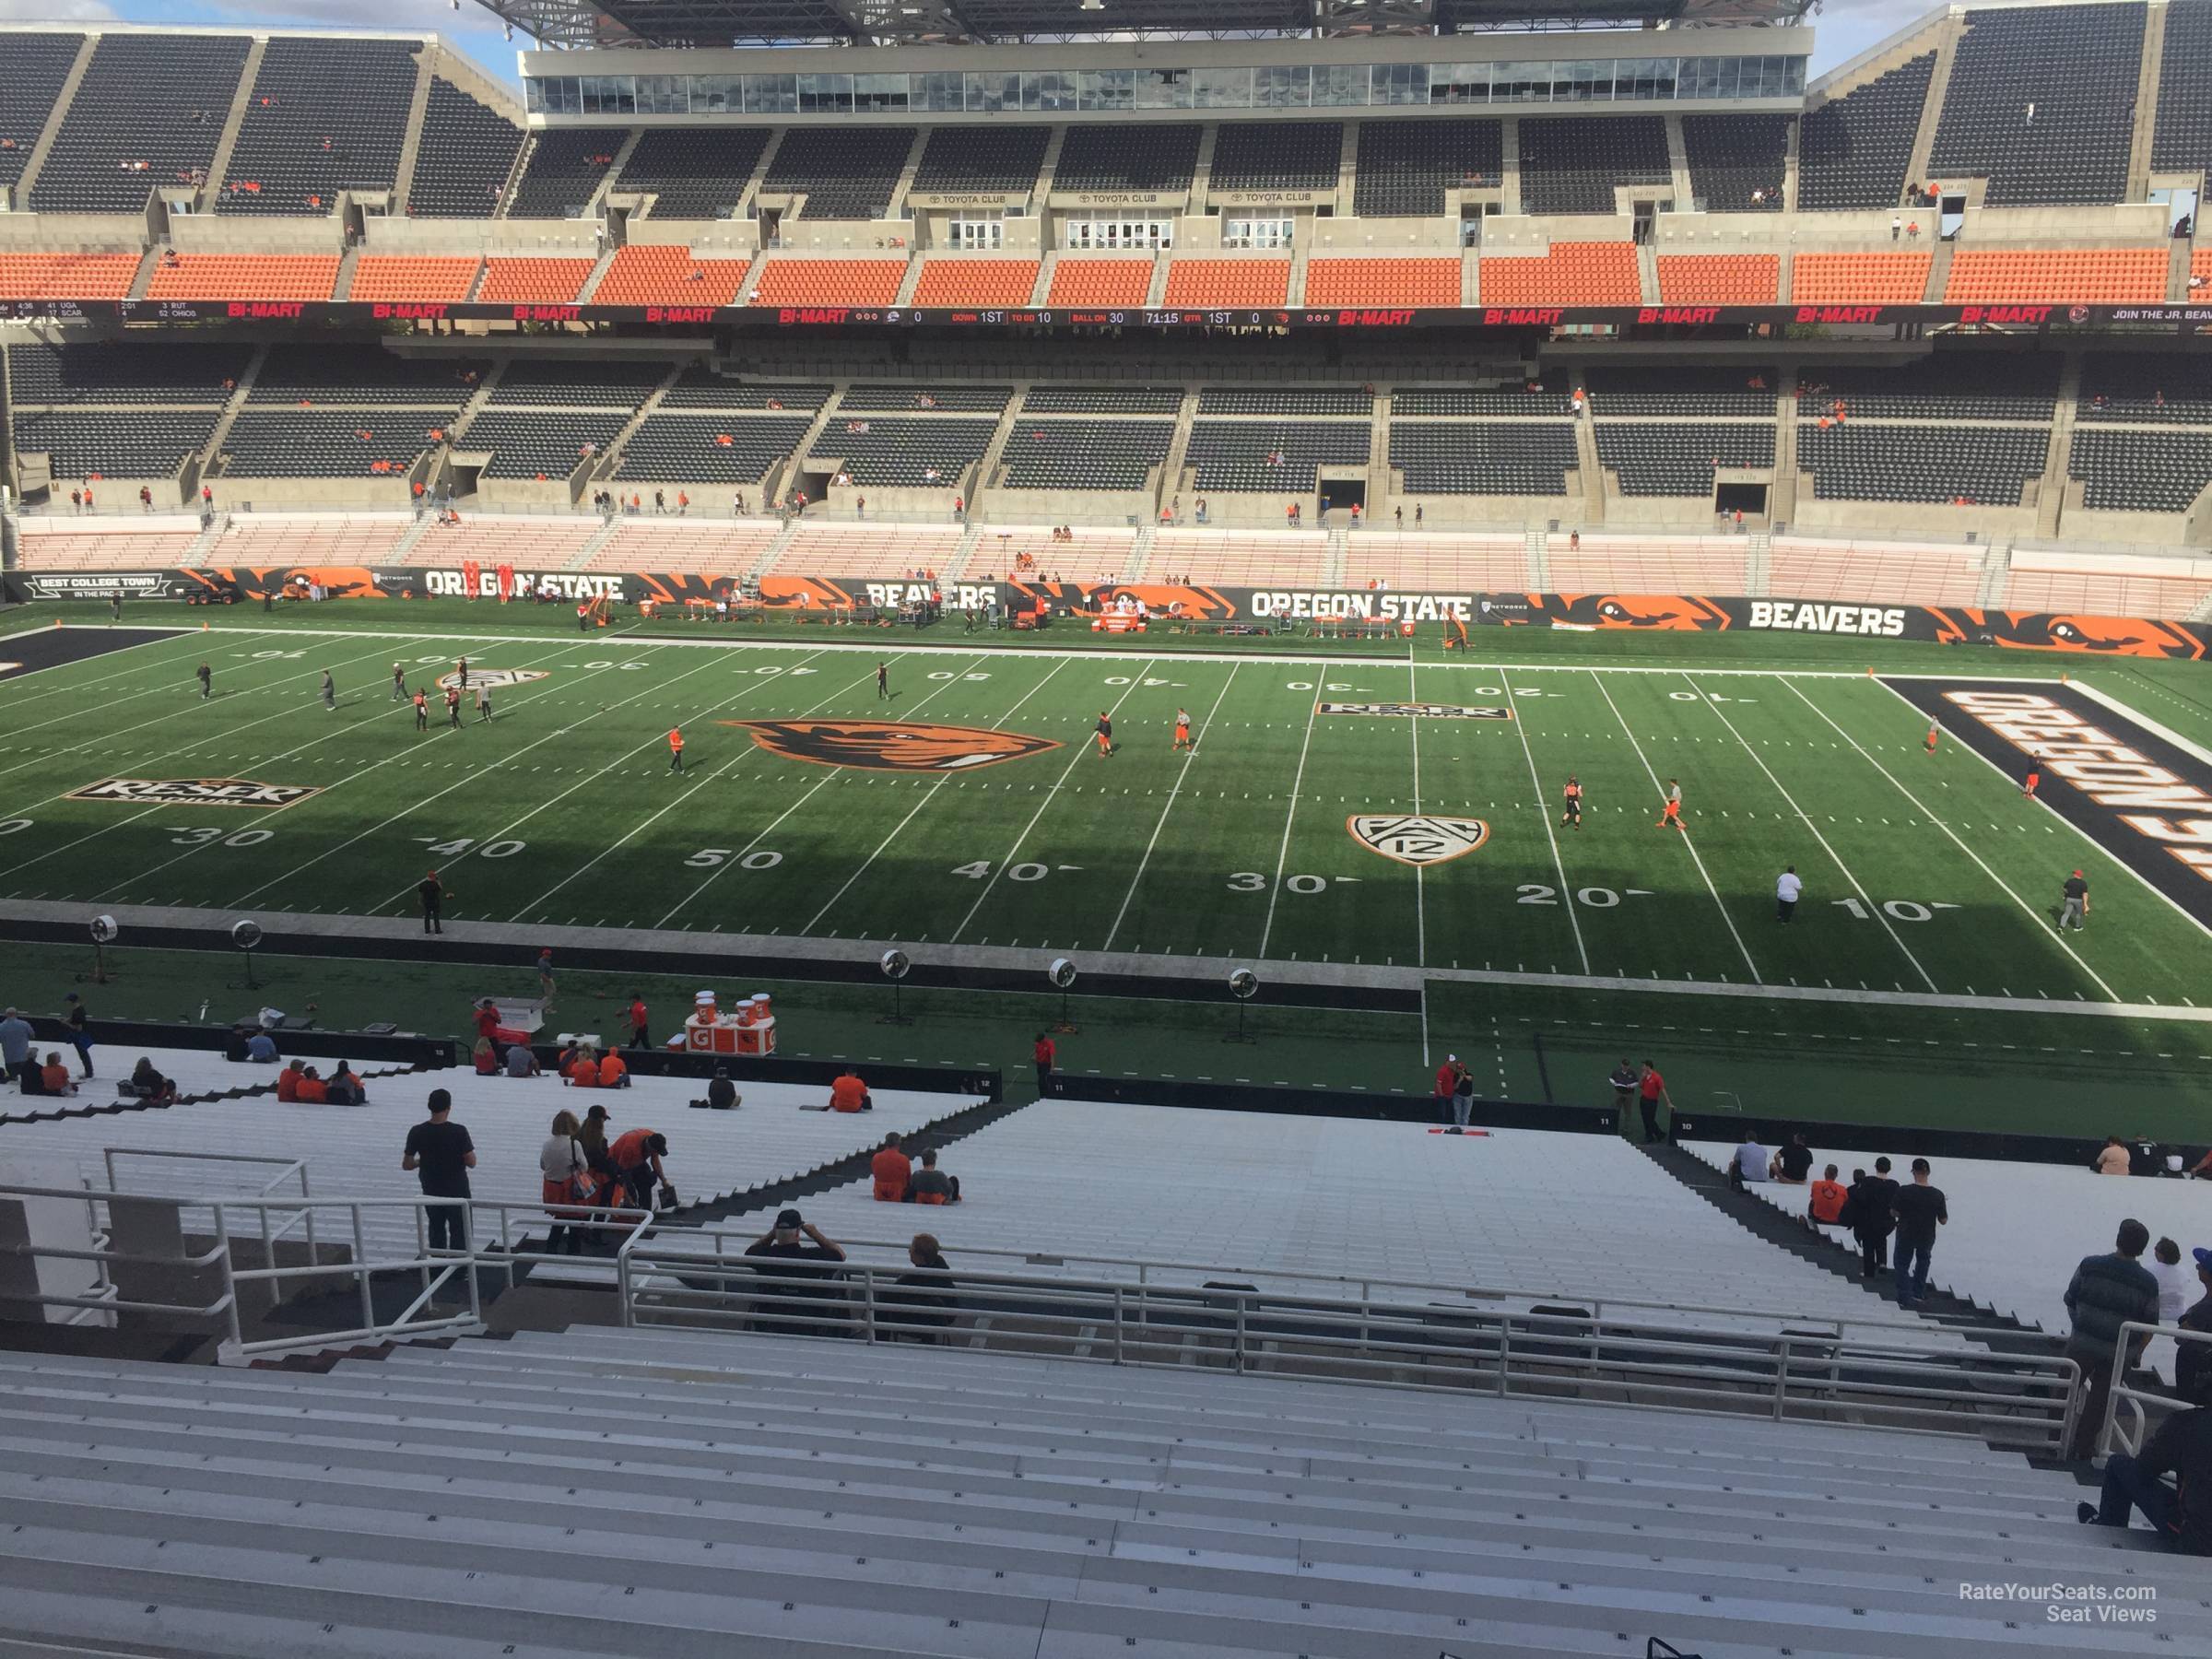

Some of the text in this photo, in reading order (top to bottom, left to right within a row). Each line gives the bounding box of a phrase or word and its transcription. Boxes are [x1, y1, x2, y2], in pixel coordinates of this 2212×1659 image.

[944, 195, 1006, 204] TOYOTA CLUB
[1093, 194, 1129, 203] TOYOTA
[1286, 193, 1311, 201] CLUB
[914, 311, 922, 323] 0
[981, 312, 1004, 323] 1ST
[1038, 312, 1051, 324] 10
[1110, 312, 1124, 324] 30
[1147, 312, 1179, 324] 71:15
[1209, 312, 1232, 324] 1ST
[1253, 312, 1260, 324] 0
[2112, 310, 2138, 319] JOIN
[2141, 310, 2164, 319] THE
[2165, 310, 2183, 319] JR.
[40, 577, 156, 587] BEST COLLEGE TOWN
[426, 571, 624, 599] ORGN STATE
[1252, 592, 1473, 621] OREGON STATE
[1748, 601, 1906, 637] BEAVERS
[84, 781, 303, 802] RESER
[170, 828, 275, 848] 30
[425, 838, 526, 859] 40
[684, 849, 783, 869] 50
[950, 861, 1049, 881] 40
[1226, 872, 1327, 894] 30
[1516, 885, 1620, 908] 20
[1831, 898, 1933, 922] 10
[693, 1030, 709, 1046] G
